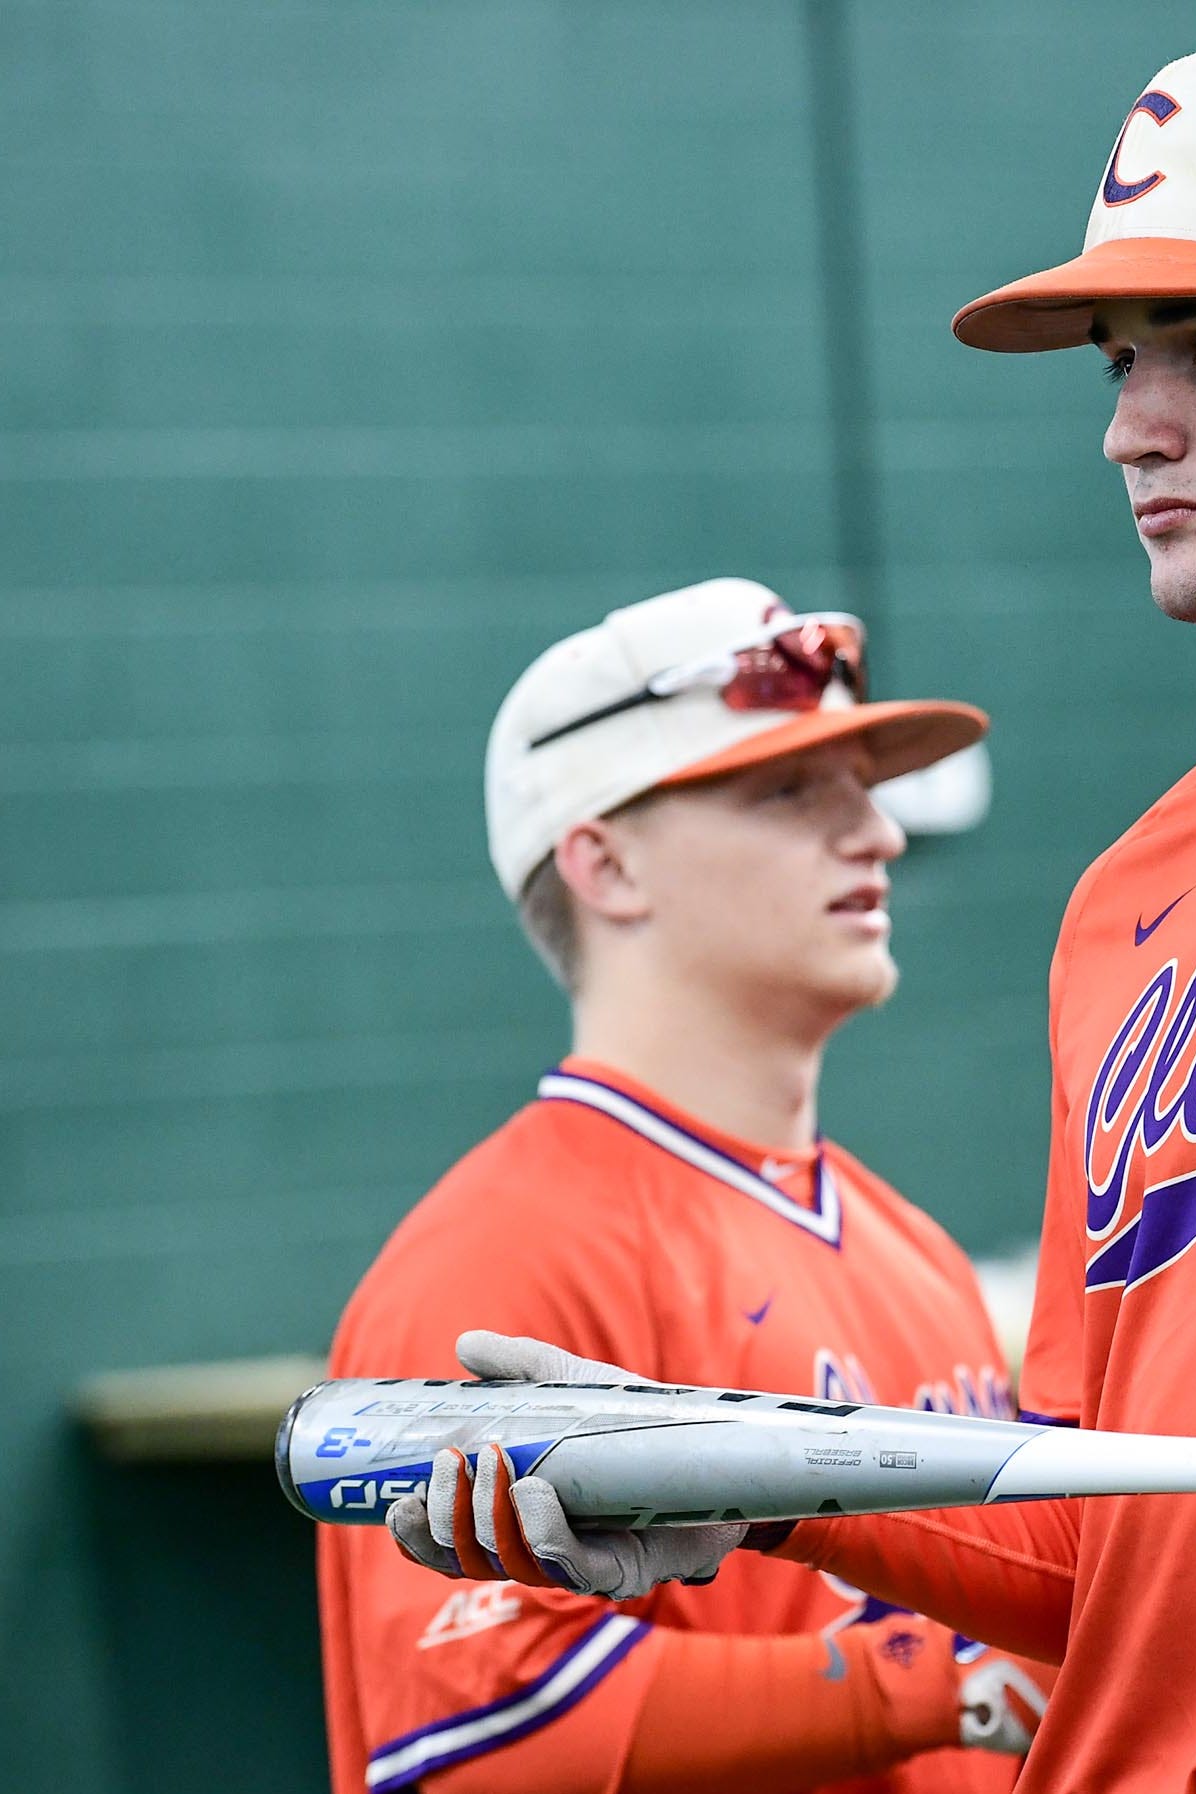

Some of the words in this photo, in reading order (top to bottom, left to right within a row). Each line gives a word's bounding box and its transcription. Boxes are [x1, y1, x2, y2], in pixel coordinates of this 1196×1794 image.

[1103, 89, 1182, 208] C
[804, 1448, 862, 1457] BASEBALL
[805, 1457, 861, 1466] OFFICIAL
